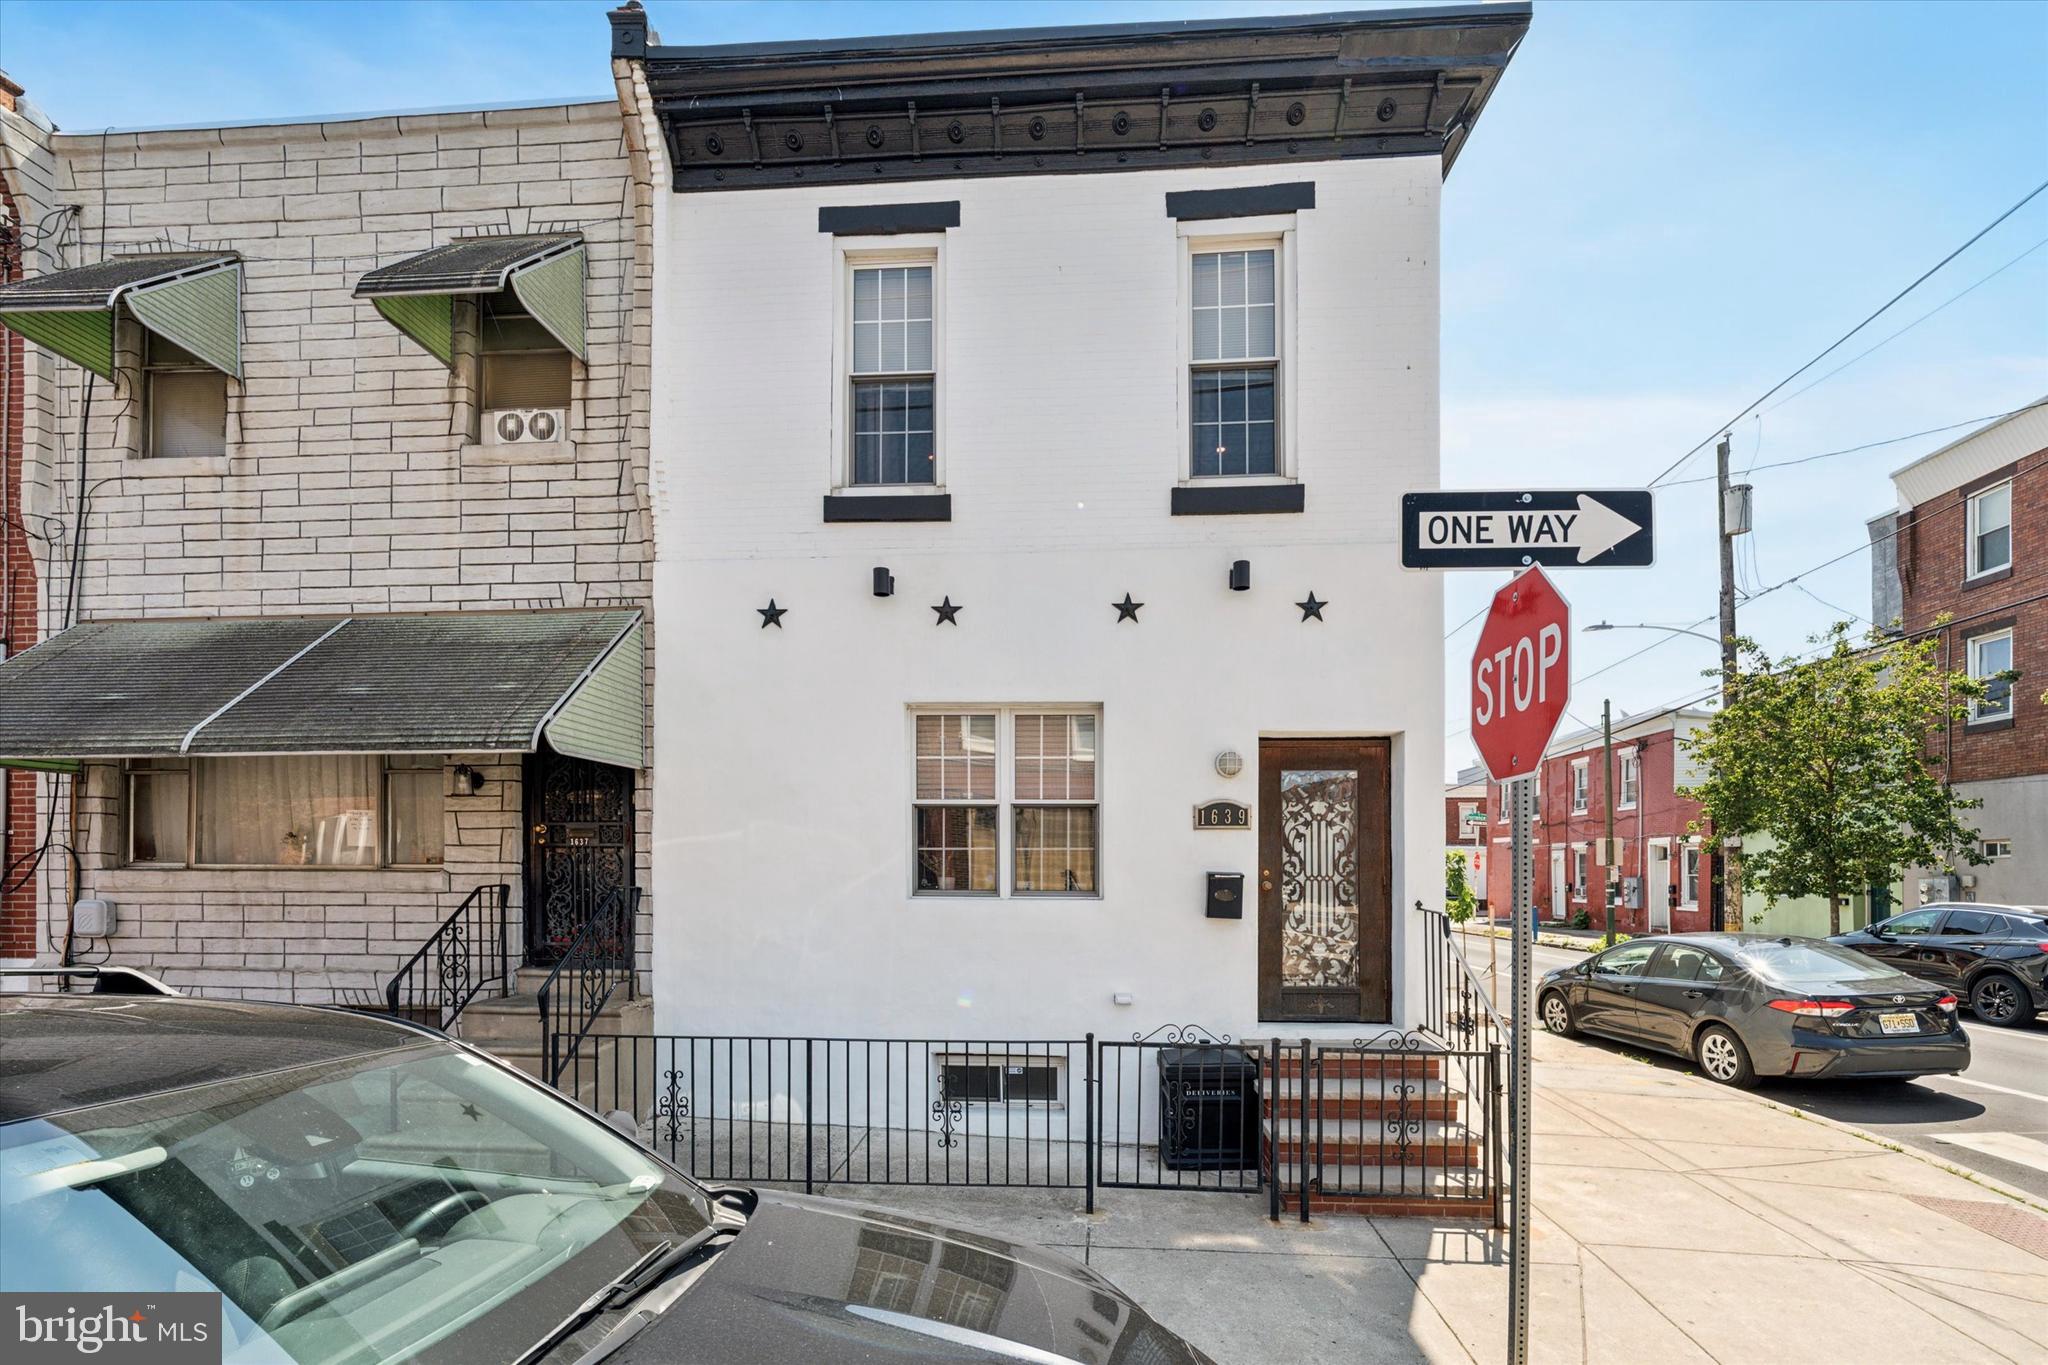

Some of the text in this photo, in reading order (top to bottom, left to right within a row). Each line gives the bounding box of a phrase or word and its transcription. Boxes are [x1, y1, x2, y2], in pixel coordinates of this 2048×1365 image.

[1428, 514, 1578, 544] ONE WAY
[1476, 622, 1562, 726] STOP
[1201, 808, 1245, 824] 1639
[570, 838, 589, 846] 1637
